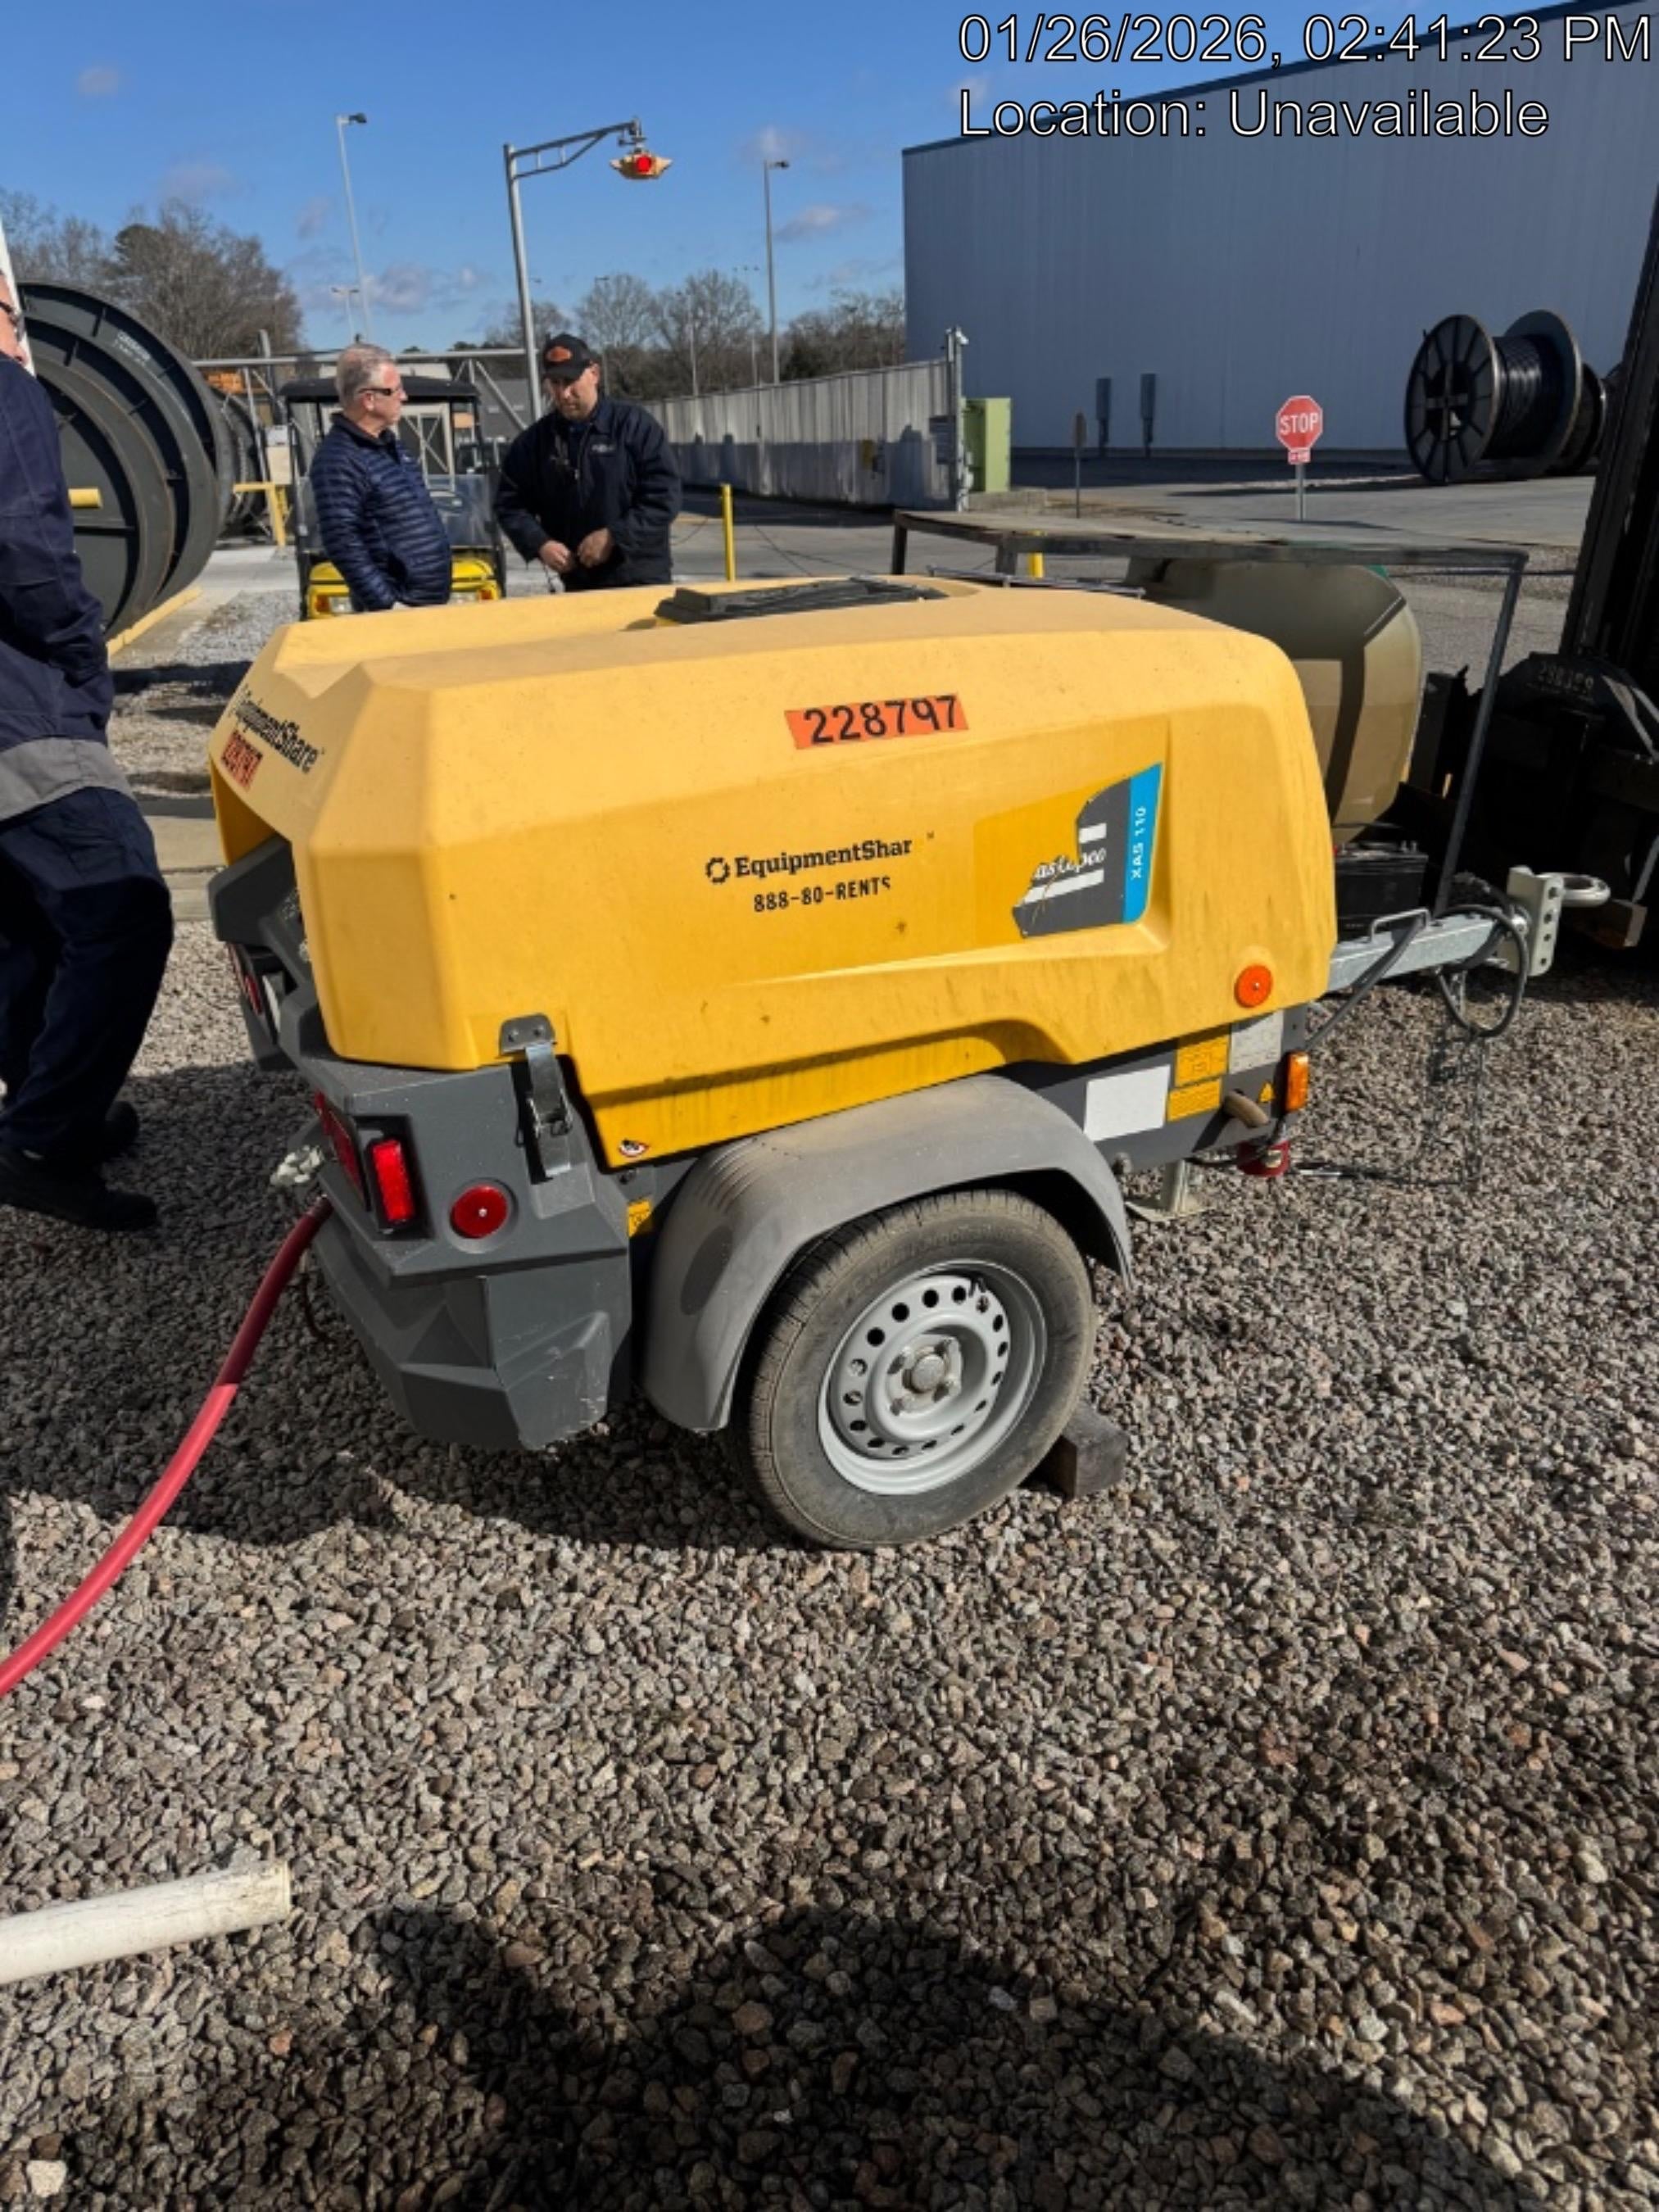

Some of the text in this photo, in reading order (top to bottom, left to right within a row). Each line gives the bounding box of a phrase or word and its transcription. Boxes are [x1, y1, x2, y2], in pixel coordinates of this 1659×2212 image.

[1281, 412, 1318, 435] STOP
[803, 696, 957, 744] 228797
[1131, 806, 1146, 880] XAS 110
